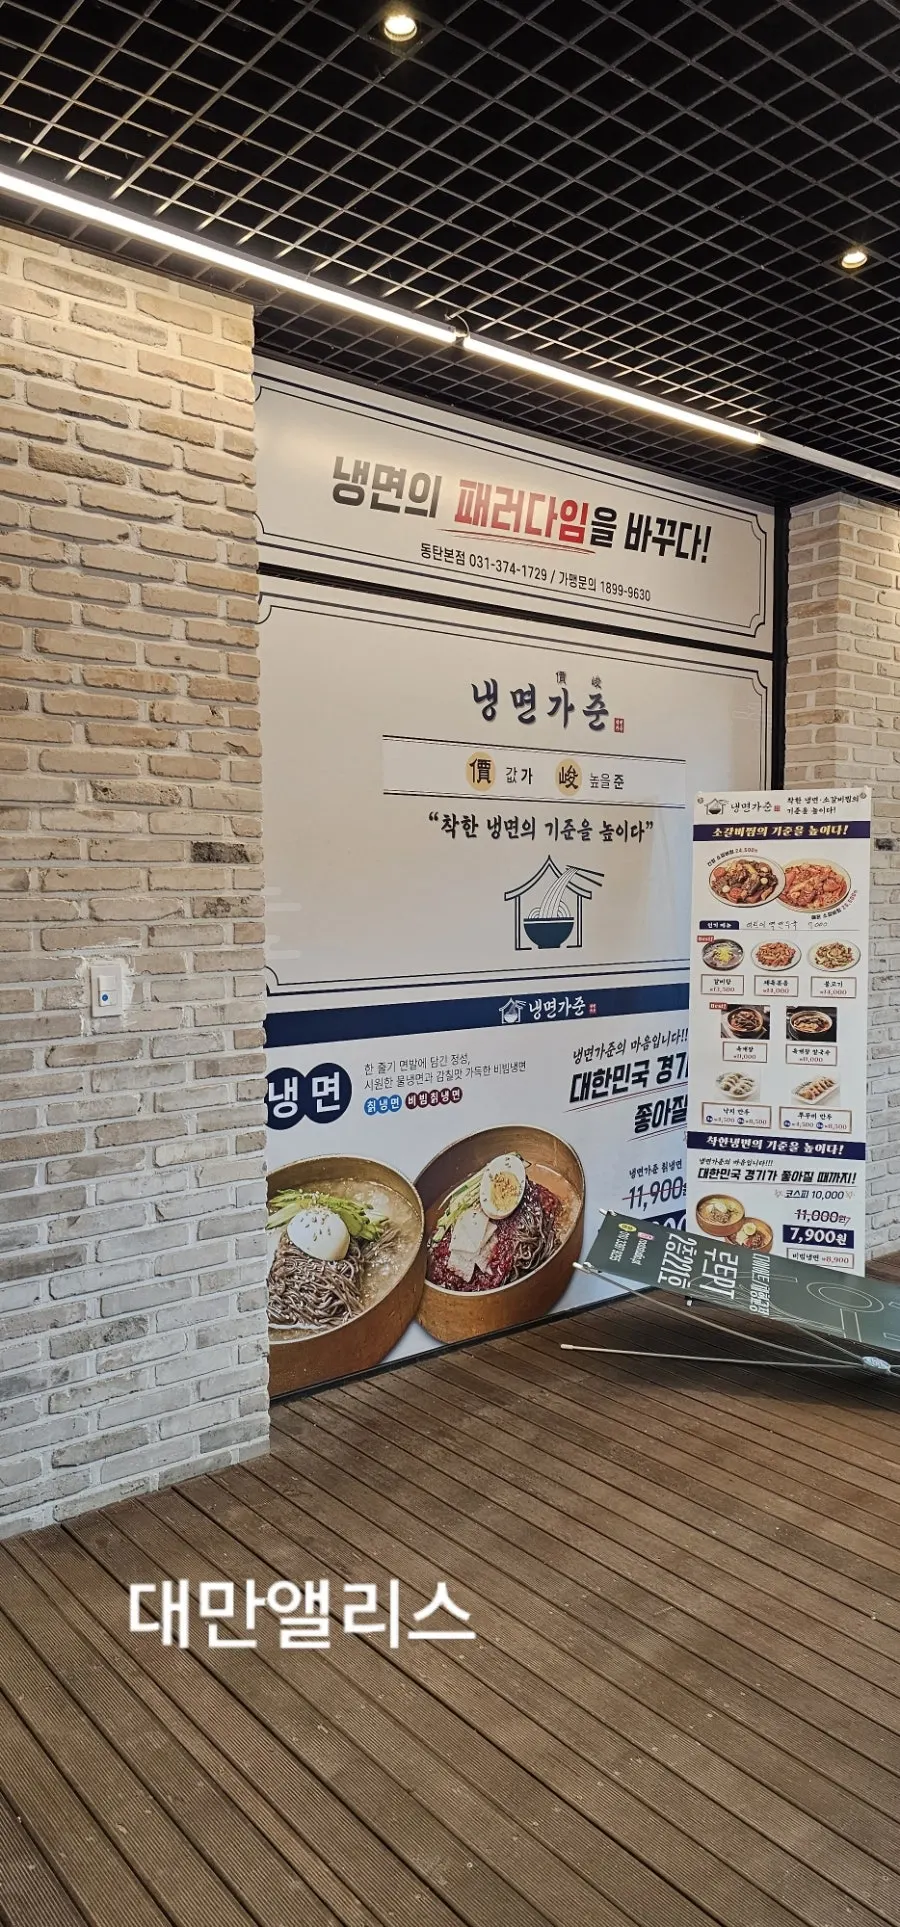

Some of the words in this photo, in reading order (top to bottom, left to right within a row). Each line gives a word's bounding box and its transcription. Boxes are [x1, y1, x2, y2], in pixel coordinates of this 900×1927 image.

[332, 456, 443, 518] 냉면의
[454, 479, 617, 548] 패러다임을
[623, 512, 712, 563] 바꾸다!
[420, 542, 466, 566] 동탄본점
[469, 554, 547, 581] 031-374-1729
[559, 571, 597, 592] 가맹문의
[600, 581, 651, 602] 1899-9630
[471, 678, 609, 731] 냉면가준
[469, 758, 492, 784] 價
[559, 765, 579, 789] 峻
[730, 801, 772, 813] 냉면가준
[487, 815, 536, 841] 냉면의
[545, 817, 593, 841] 기준을
[711, 826, 767, 838] 소갈비찜의
[771, 825, 804, 837] 기준을
[808, 824, 848, 836] 높이다!
[529, 996, 585, 1020] 냉면가준
[364, 1062, 374, 1076] 한
[377, 1060, 396, 1074] 줄기
[400, 1057, 427, 1072] 면발에
[430, 1054, 449, 1069] 담긴
[450, 1053, 470, 1066] 정성,
[573, 1041, 626, 1065] 냉면가준의
[364, 1076, 393, 1091] 시원한
[396, 1072, 433, 1088] 물냉면과
[436, 1068, 462, 1083] 감칠맛
[465, 1064, 491, 1078] 가득한
[493, 1060, 526, 1075] 비빔냉면
[569, 1059, 650, 1103] 대한민국
[268, 1071, 340, 1119] 냉면
[706, 1135, 763, 1150] 착한냉면의
[766, 1140, 799, 1153] 기준을
[803, 1142, 844, 1155] 높이다!
[629, 1163, 659, 1179] 냉면가준
[697, 1167, 741, 1181] 대한민국
[744, 1169, 778, 1182] 경기가
[780, 1170, 815, 1183] 좋아질
[817, 1172, 857, 1185] 때까지!
[784, 1190, 809, 1199] 코스피
[811, 1190, 844, 1200] 10,000
[790, 1227, 847, 1246] 7,900원
